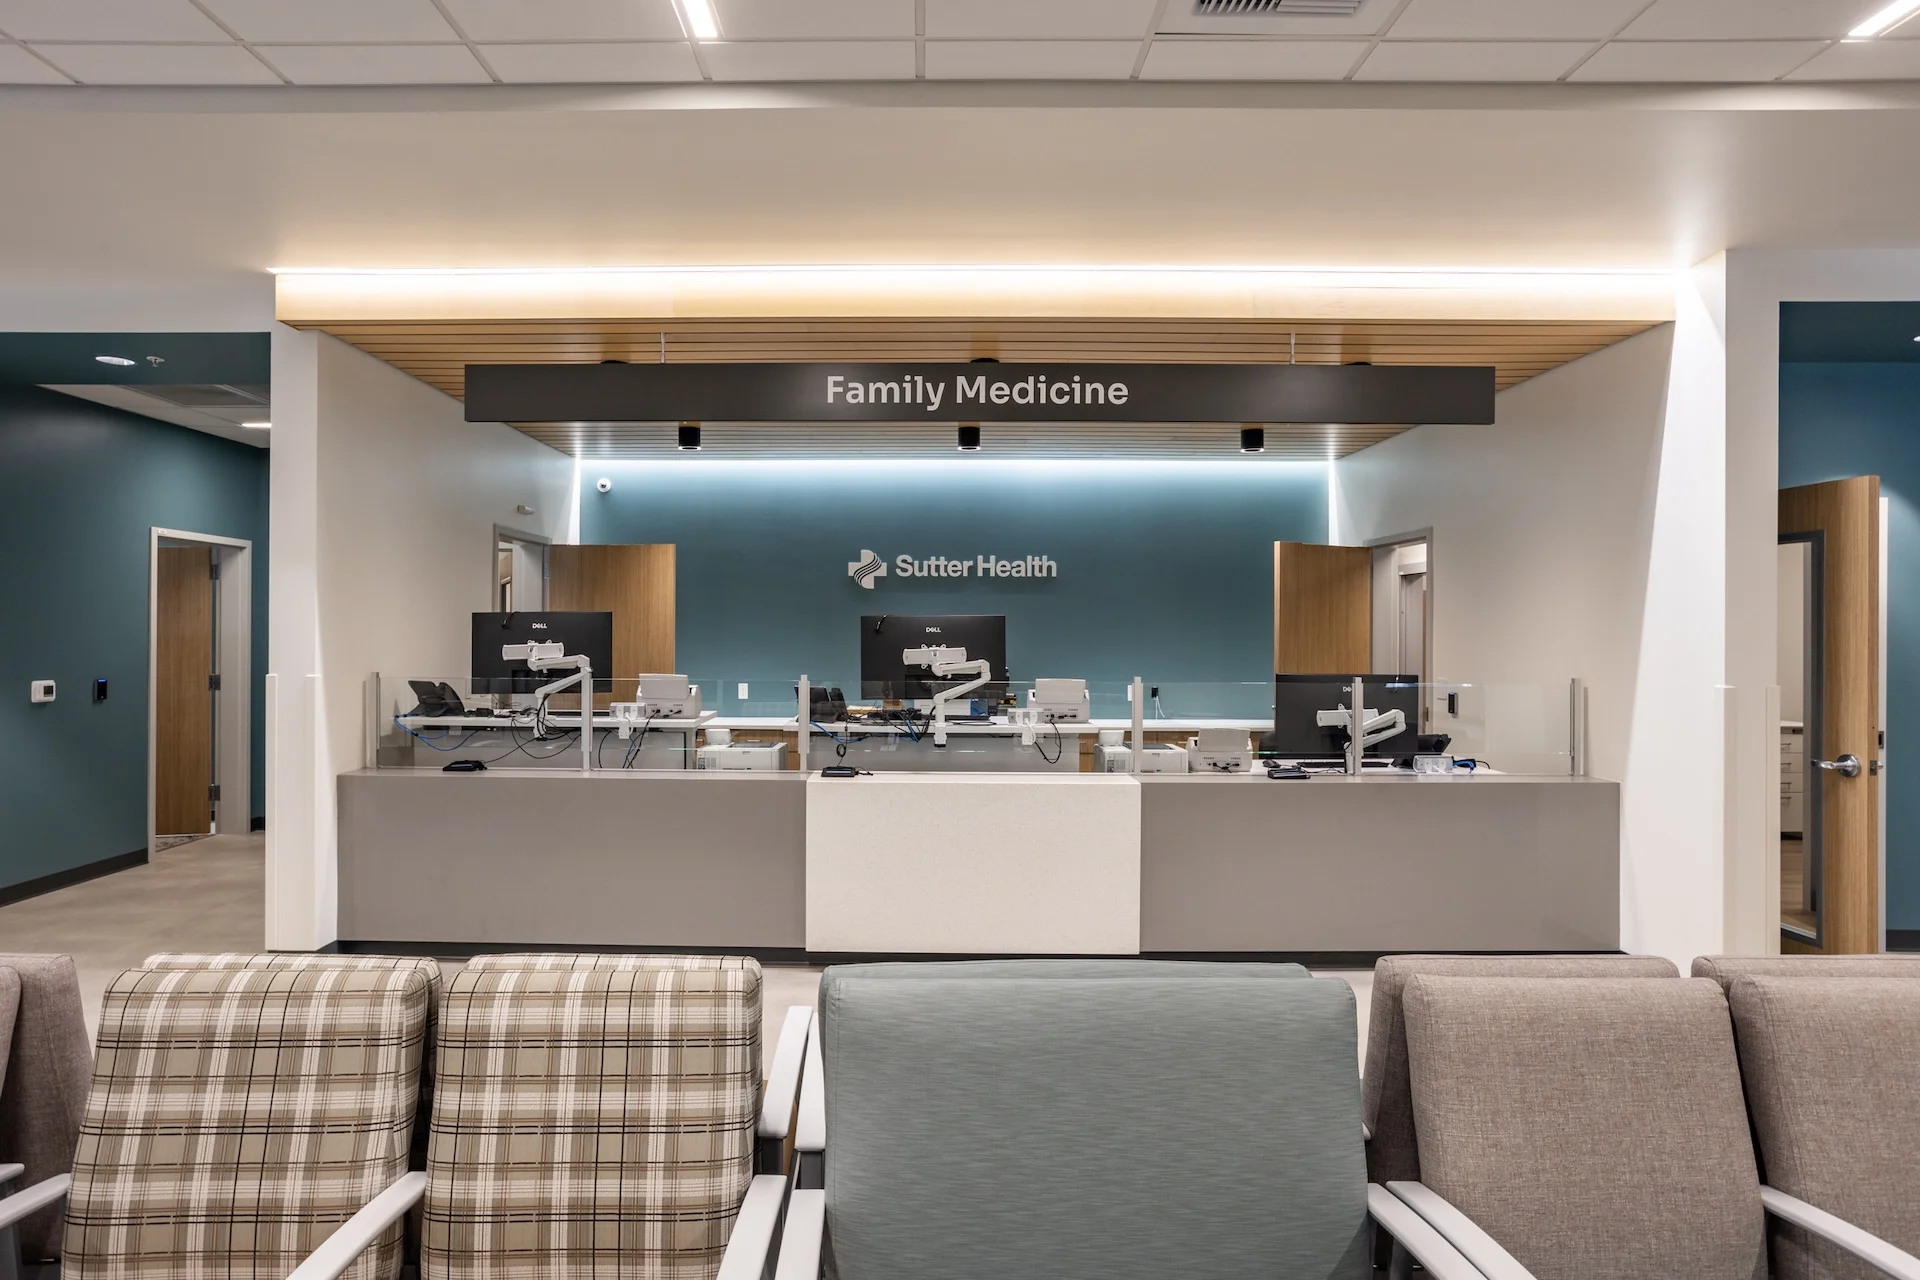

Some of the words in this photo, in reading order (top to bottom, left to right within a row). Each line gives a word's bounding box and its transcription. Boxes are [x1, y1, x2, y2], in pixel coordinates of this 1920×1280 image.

[826, 375, 946, 411] Family
[956, 375, 1129, 405] Medicine
[895, 554, 974, 578] Sutter
[977, 554, 1058, 578] Health
